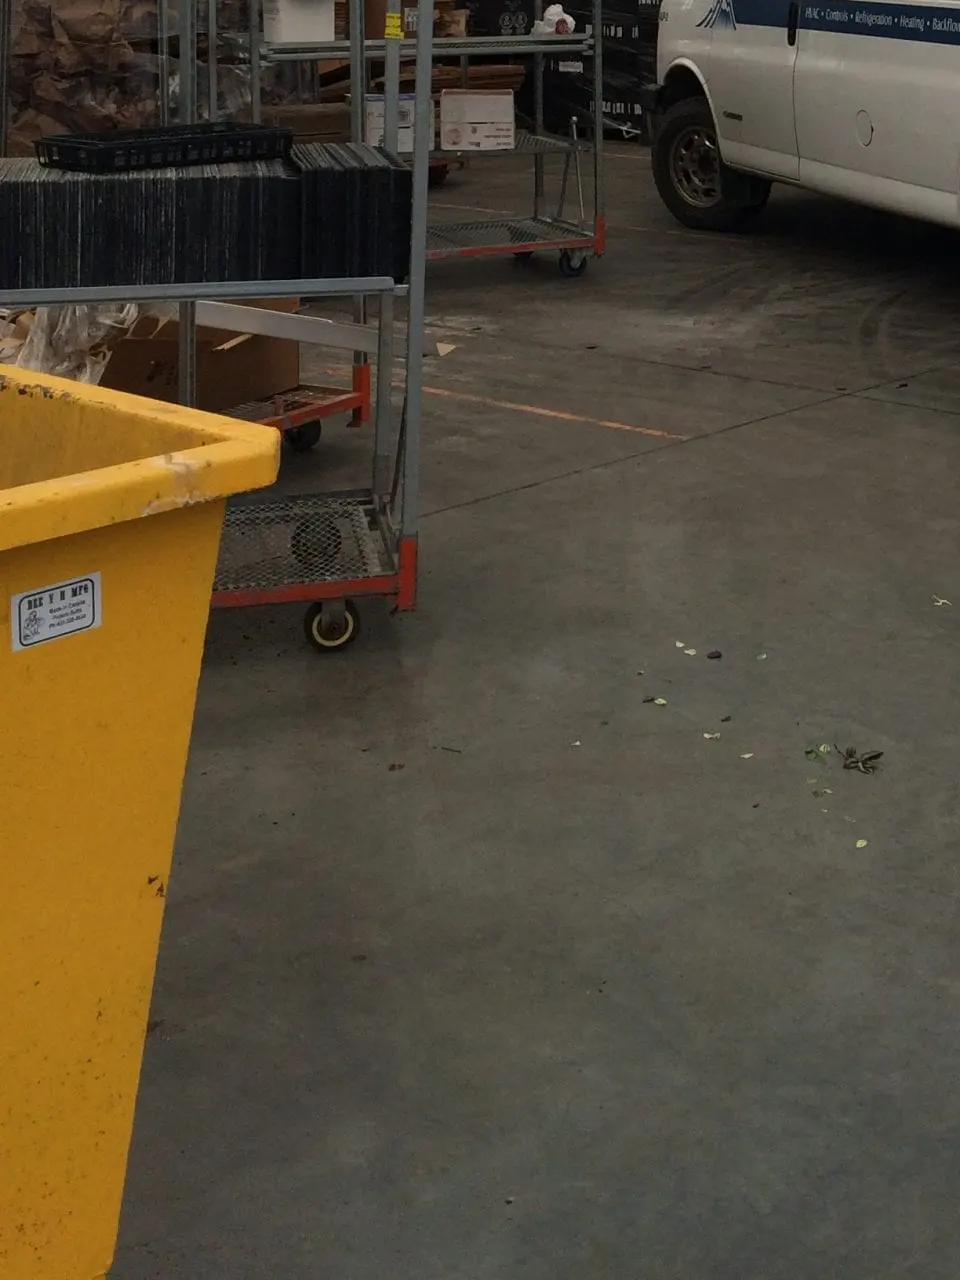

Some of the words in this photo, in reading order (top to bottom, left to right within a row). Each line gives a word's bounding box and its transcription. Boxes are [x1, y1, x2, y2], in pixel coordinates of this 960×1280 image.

[805, 7, 820, 19] HVAC
[825, 8, 848, 22] Controls
[855, 10, 892, 27] Refrigeration
[900, 15, 924, 32] Heating
